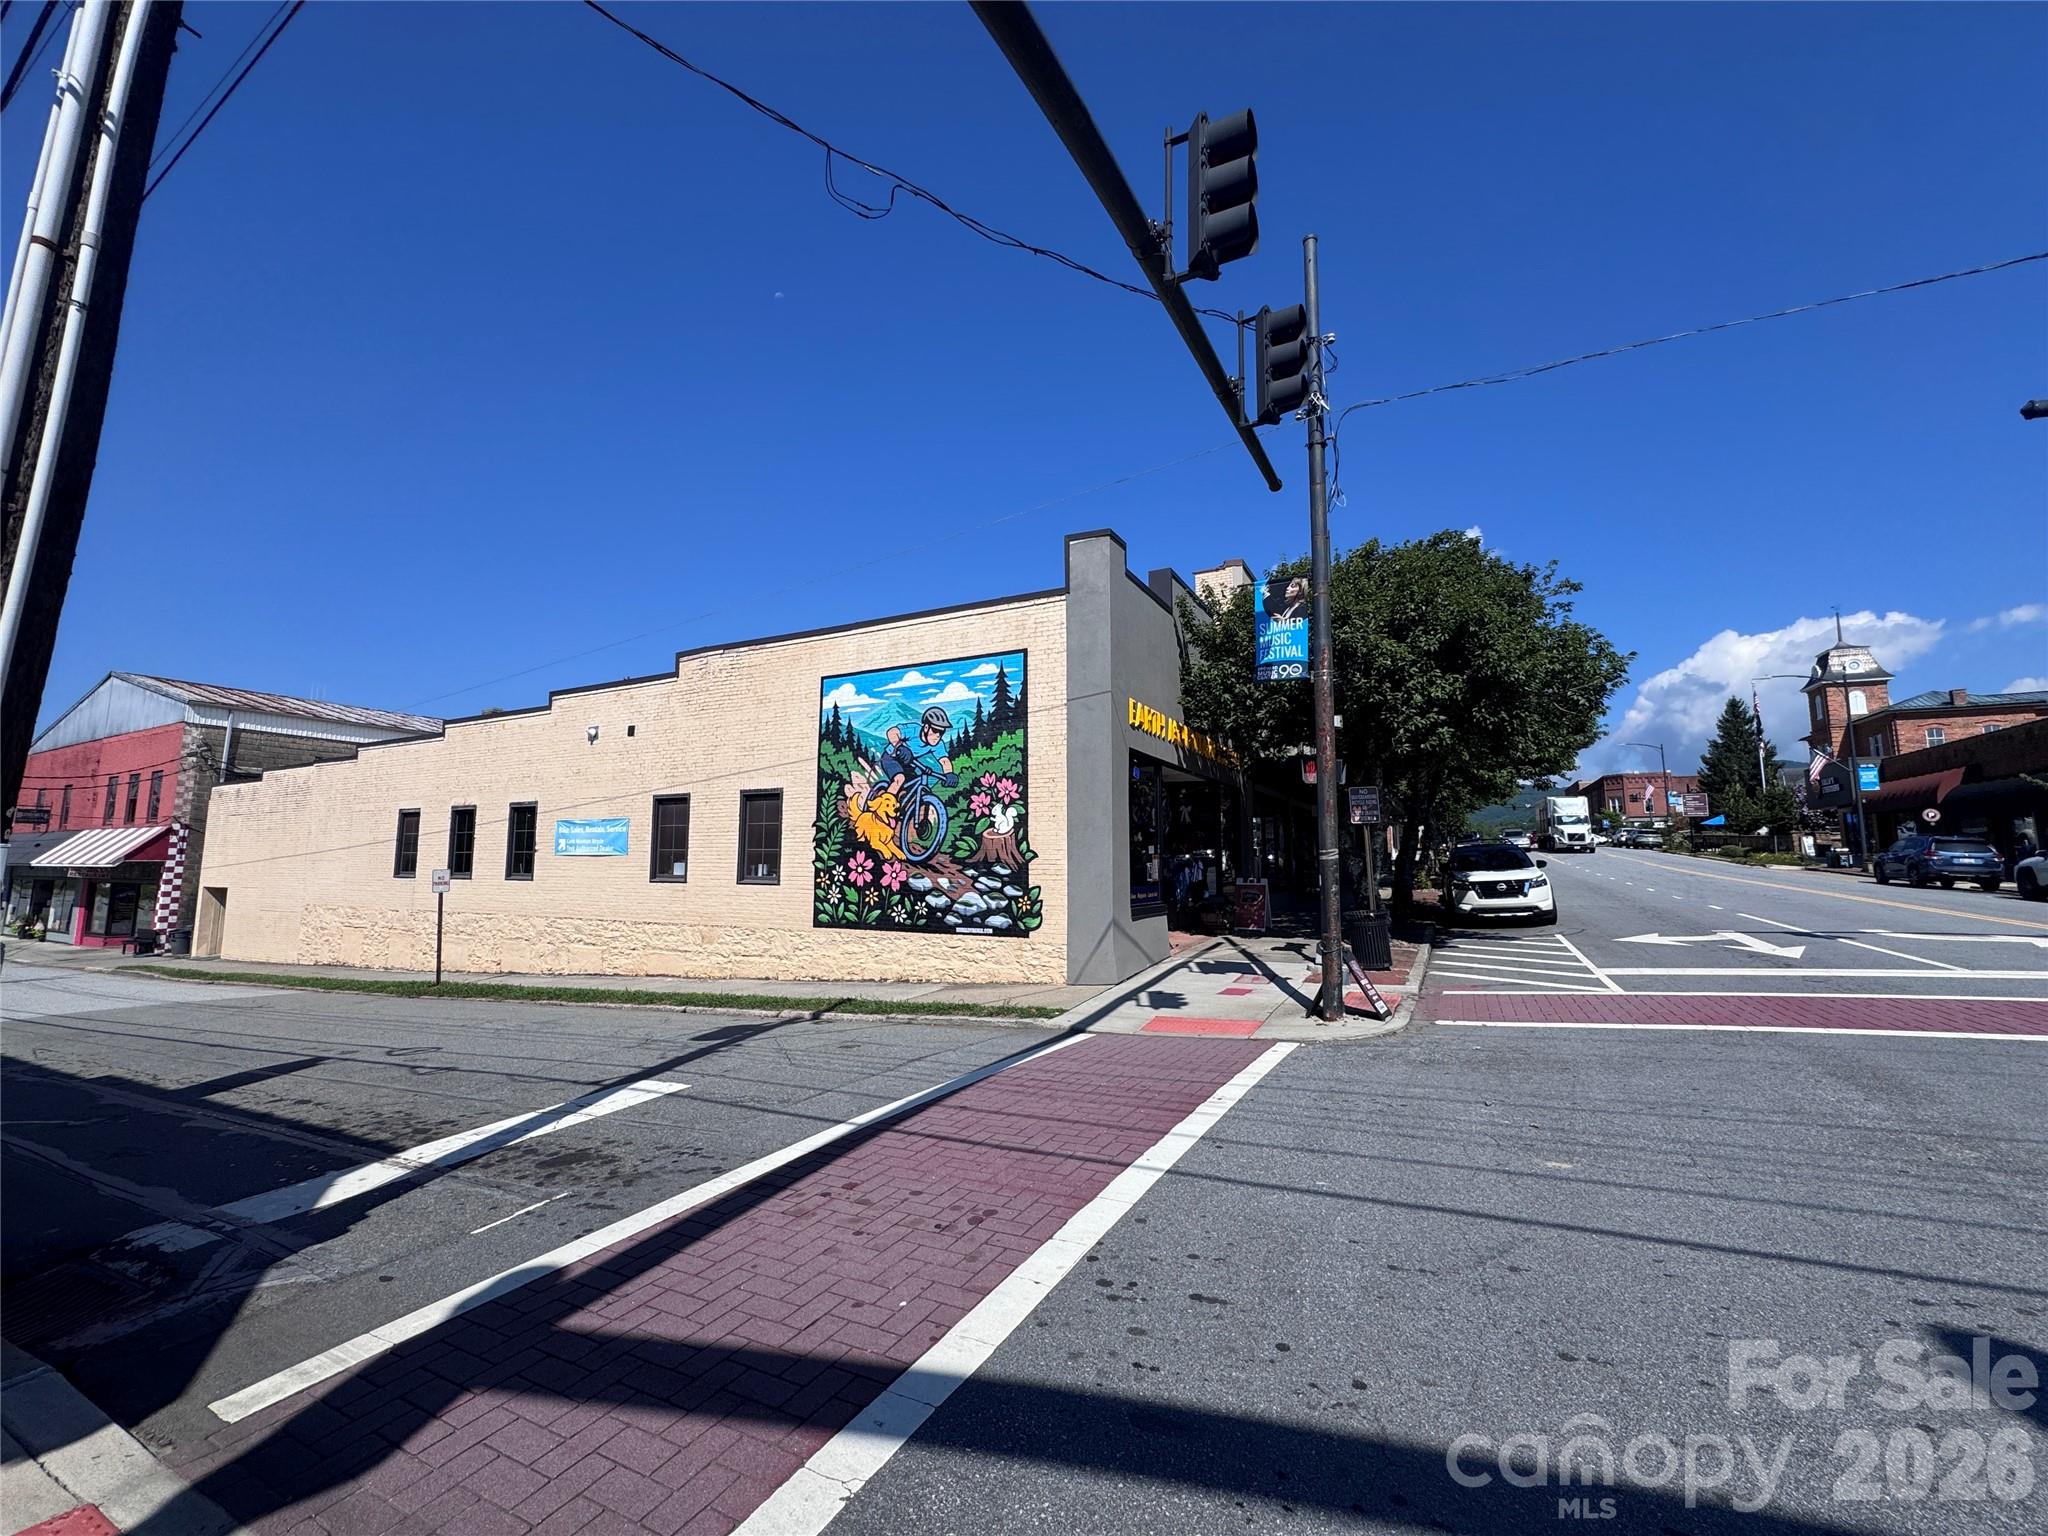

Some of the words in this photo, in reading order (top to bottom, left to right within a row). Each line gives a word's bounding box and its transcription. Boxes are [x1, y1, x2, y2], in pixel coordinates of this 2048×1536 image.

[1259, 617, 1304, 635] SUMMER
[1260, 632, 1292, 648] MUSIC
[1259, 645, 1304, 661] FESTIVAL
[1278, 663, 1303, 679] 90
[1128, 697, 1166, 741] EARTH
